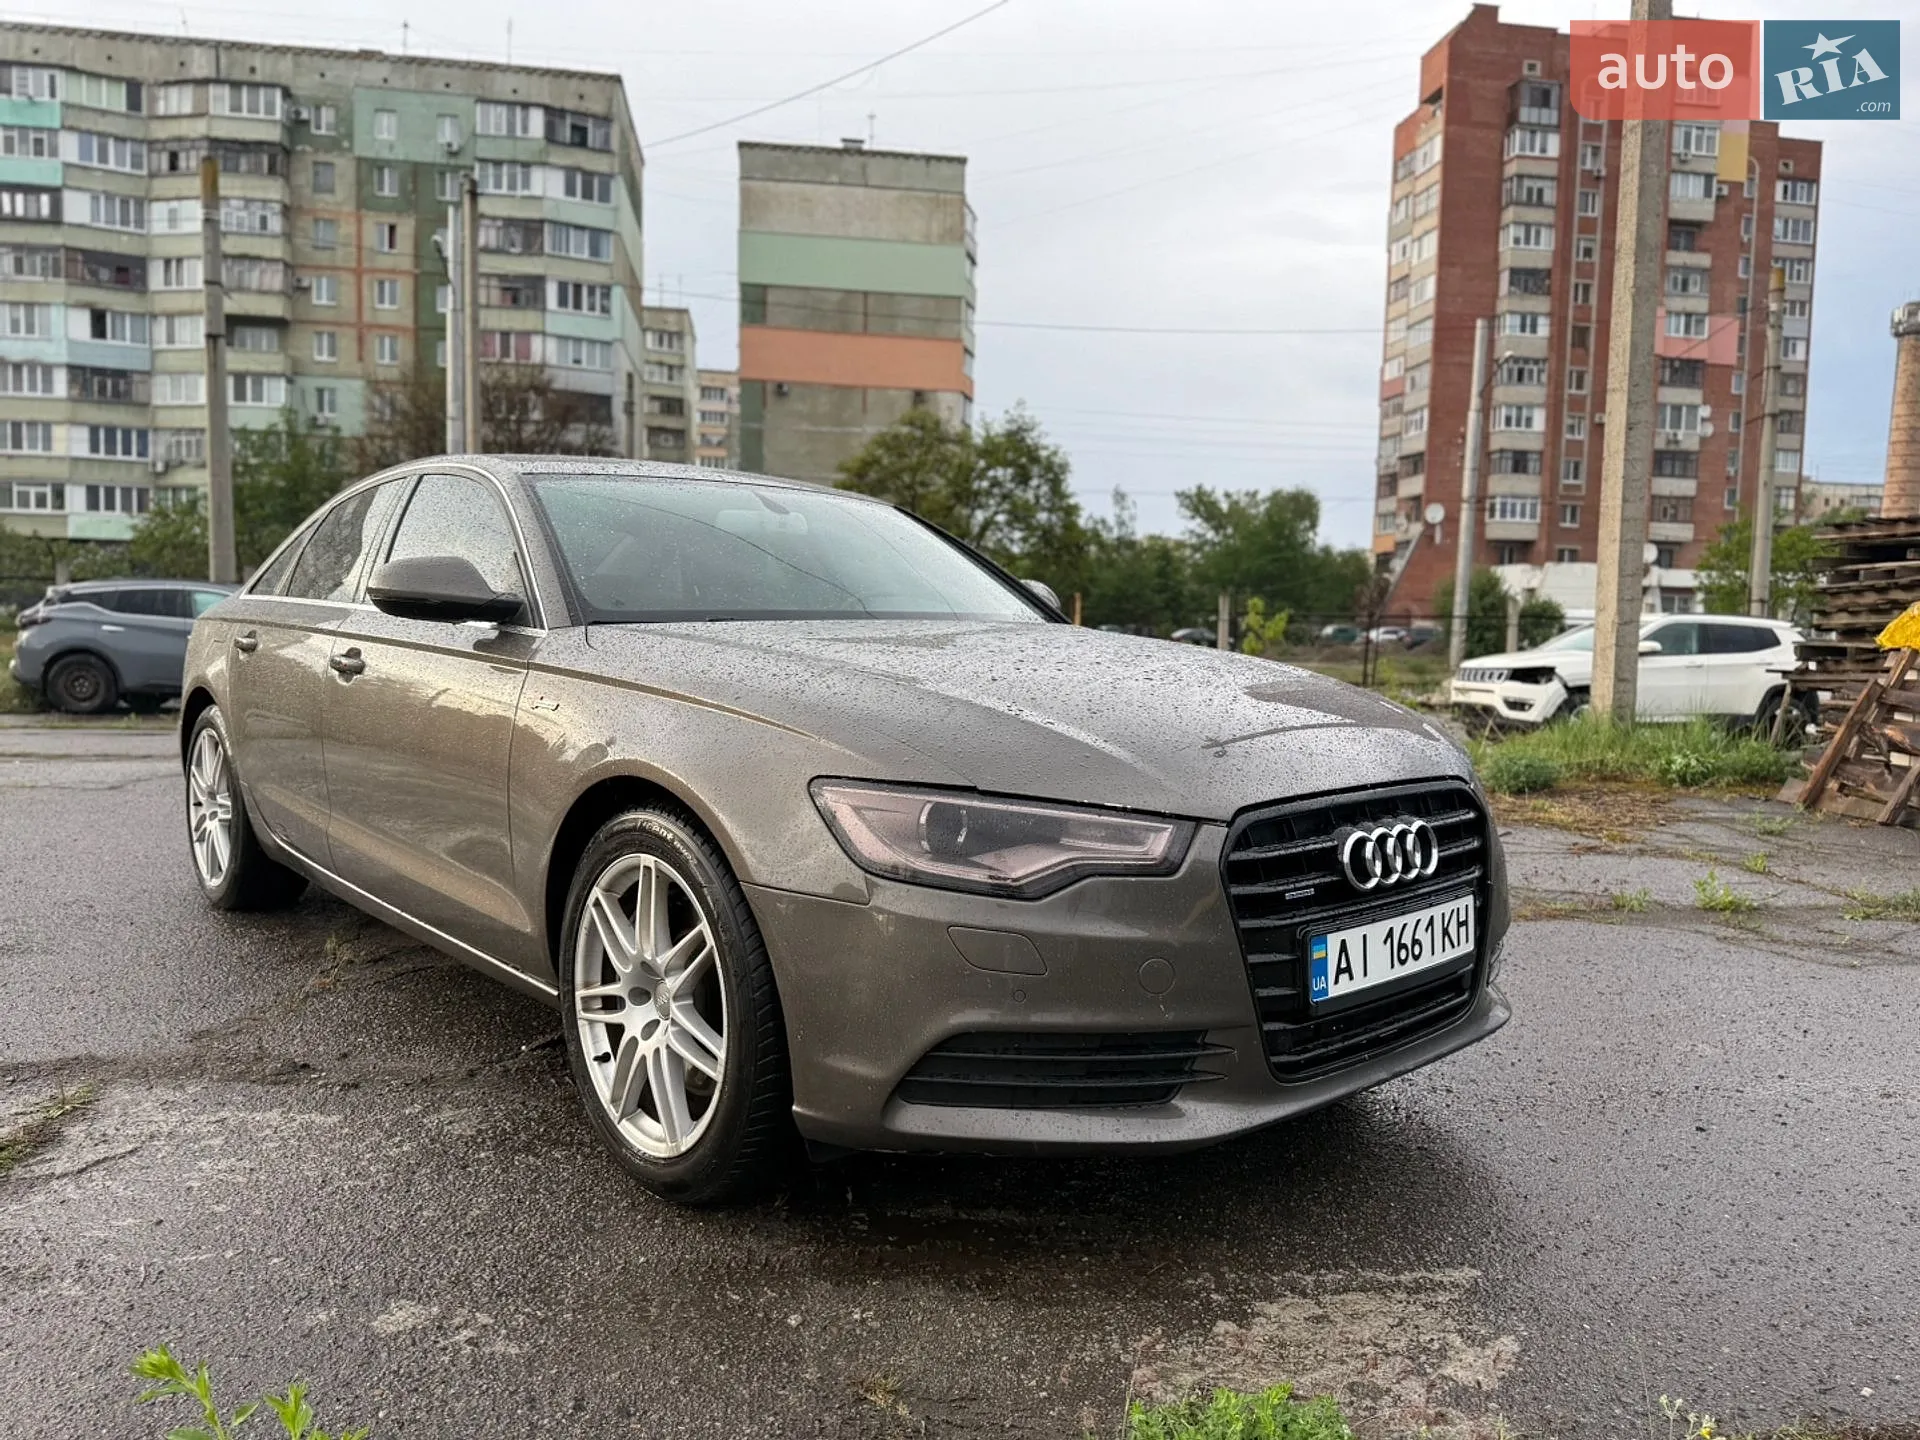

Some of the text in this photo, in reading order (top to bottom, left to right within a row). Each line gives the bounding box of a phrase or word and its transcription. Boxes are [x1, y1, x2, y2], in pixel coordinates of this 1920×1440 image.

[1333, 934, 1368, 986] AI
[1383, 915, 1435, 970] 1661
[1312, 976, 1327, 991] UA
